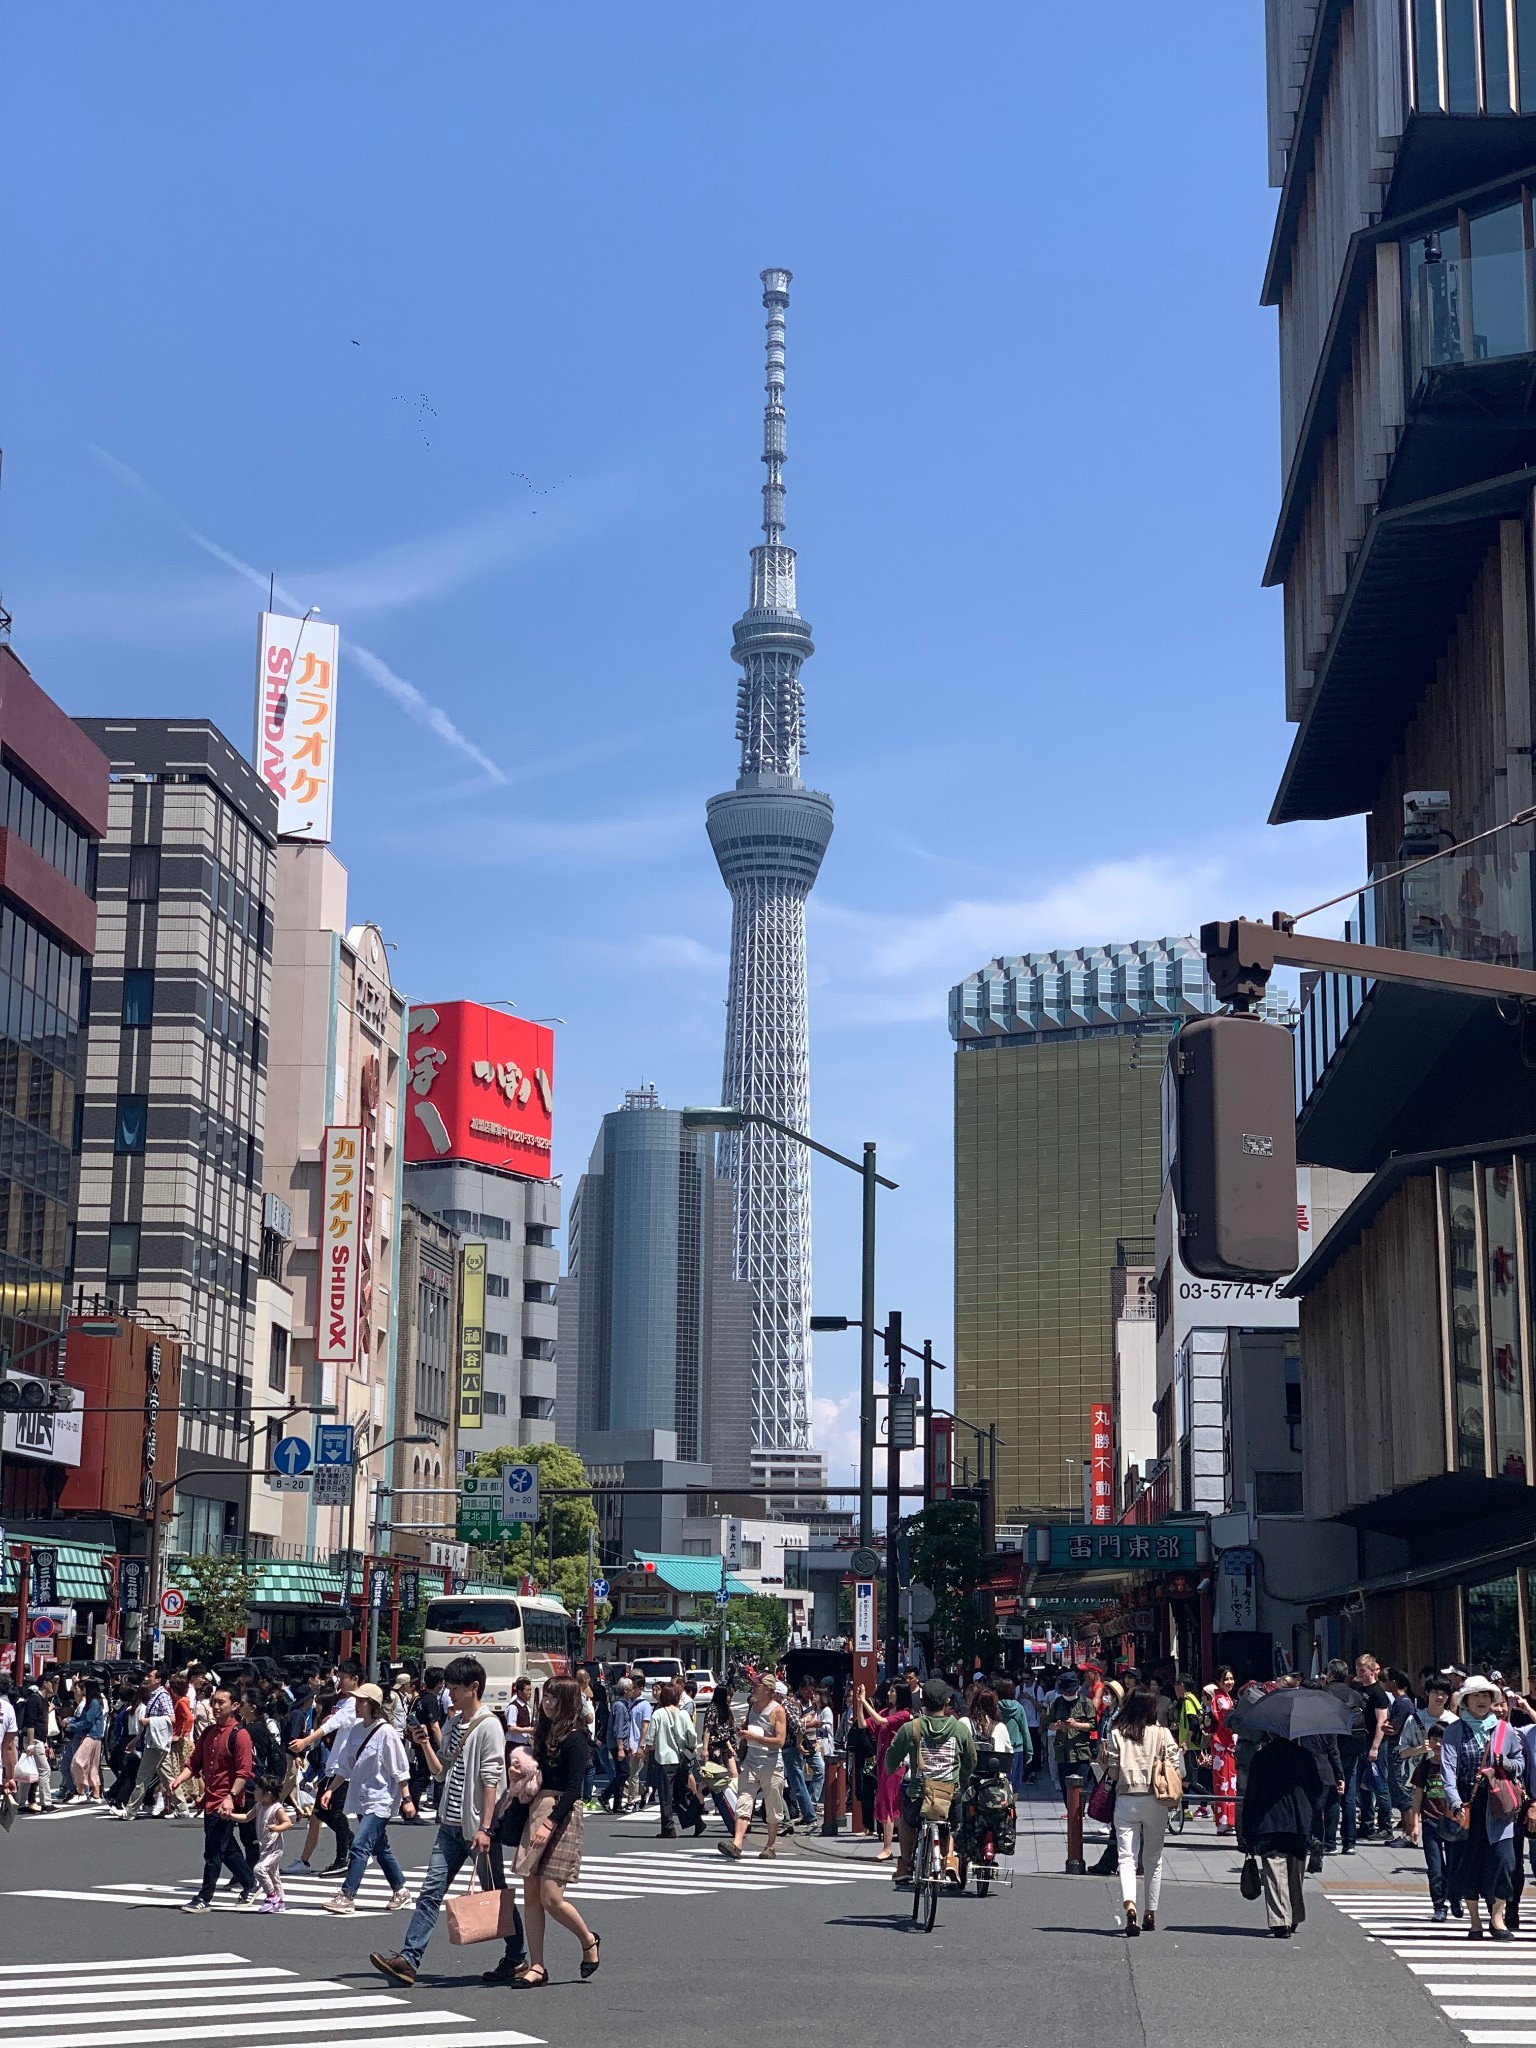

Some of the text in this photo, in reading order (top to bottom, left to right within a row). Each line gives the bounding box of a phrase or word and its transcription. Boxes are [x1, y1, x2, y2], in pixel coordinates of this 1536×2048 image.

[262, 645, 292, 800] SHIDAX
[290, 652, 331, 803] カラオケ
[328, 1136, 355, 1350] カラオケ SHIDAX
[462, 1328, 480, 1414] 神谷バー
[1093, 1410, 1111, 1521] 丸勝不動産
[467, 1481, 474, 1490] 6
[480, 1482, 502, 1491] 首都
[462, 1511, 490, 1521] 東北道
[729, 1524, 737, 1559] 水上バス
[1068, 1534, 1180, 1559] 雷門東部
[39, 1566, 51, 1603] 三社祭
[127, 1576, 138, 1609] 三社祭
[373, 1581, 383, 1607] 三社祭
[446, 1635, 496, 1645] TOYA
